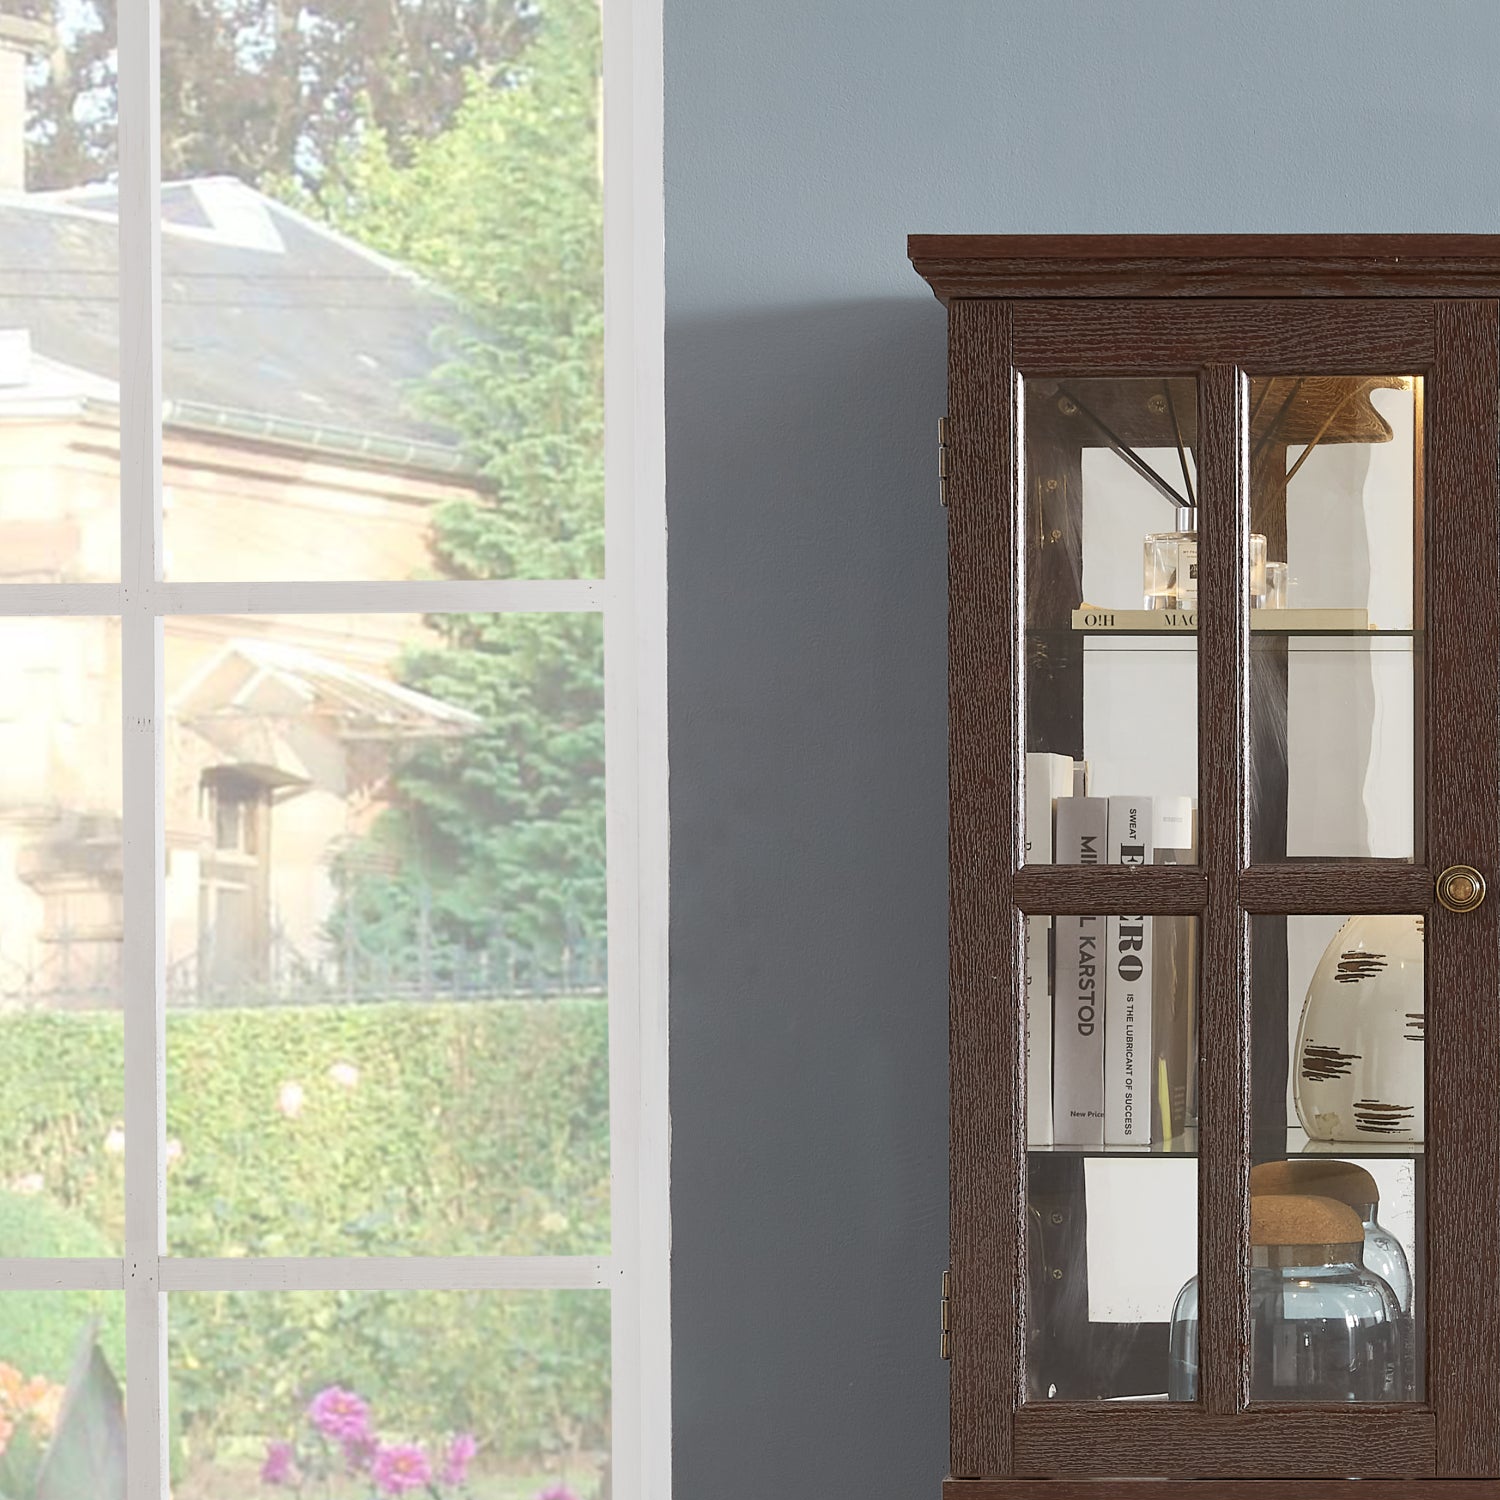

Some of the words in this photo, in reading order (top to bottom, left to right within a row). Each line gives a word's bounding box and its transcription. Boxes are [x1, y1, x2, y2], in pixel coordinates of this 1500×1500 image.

[1129, 808, 1137, 840] SWEAT
[1118, 915, 1144, 982] RO
[1077, 936, 1096, 1037] KARSTOD
[1126, 993, 1134, 1003] IS
[1126, 1004, 1134, 1023] THE
[1125, 1024, 1134, 1076] LUBRICANT
[1125, 1078, 1133, 1090] OF
[1124, 1092, 1133, 1136] SUCCESS
